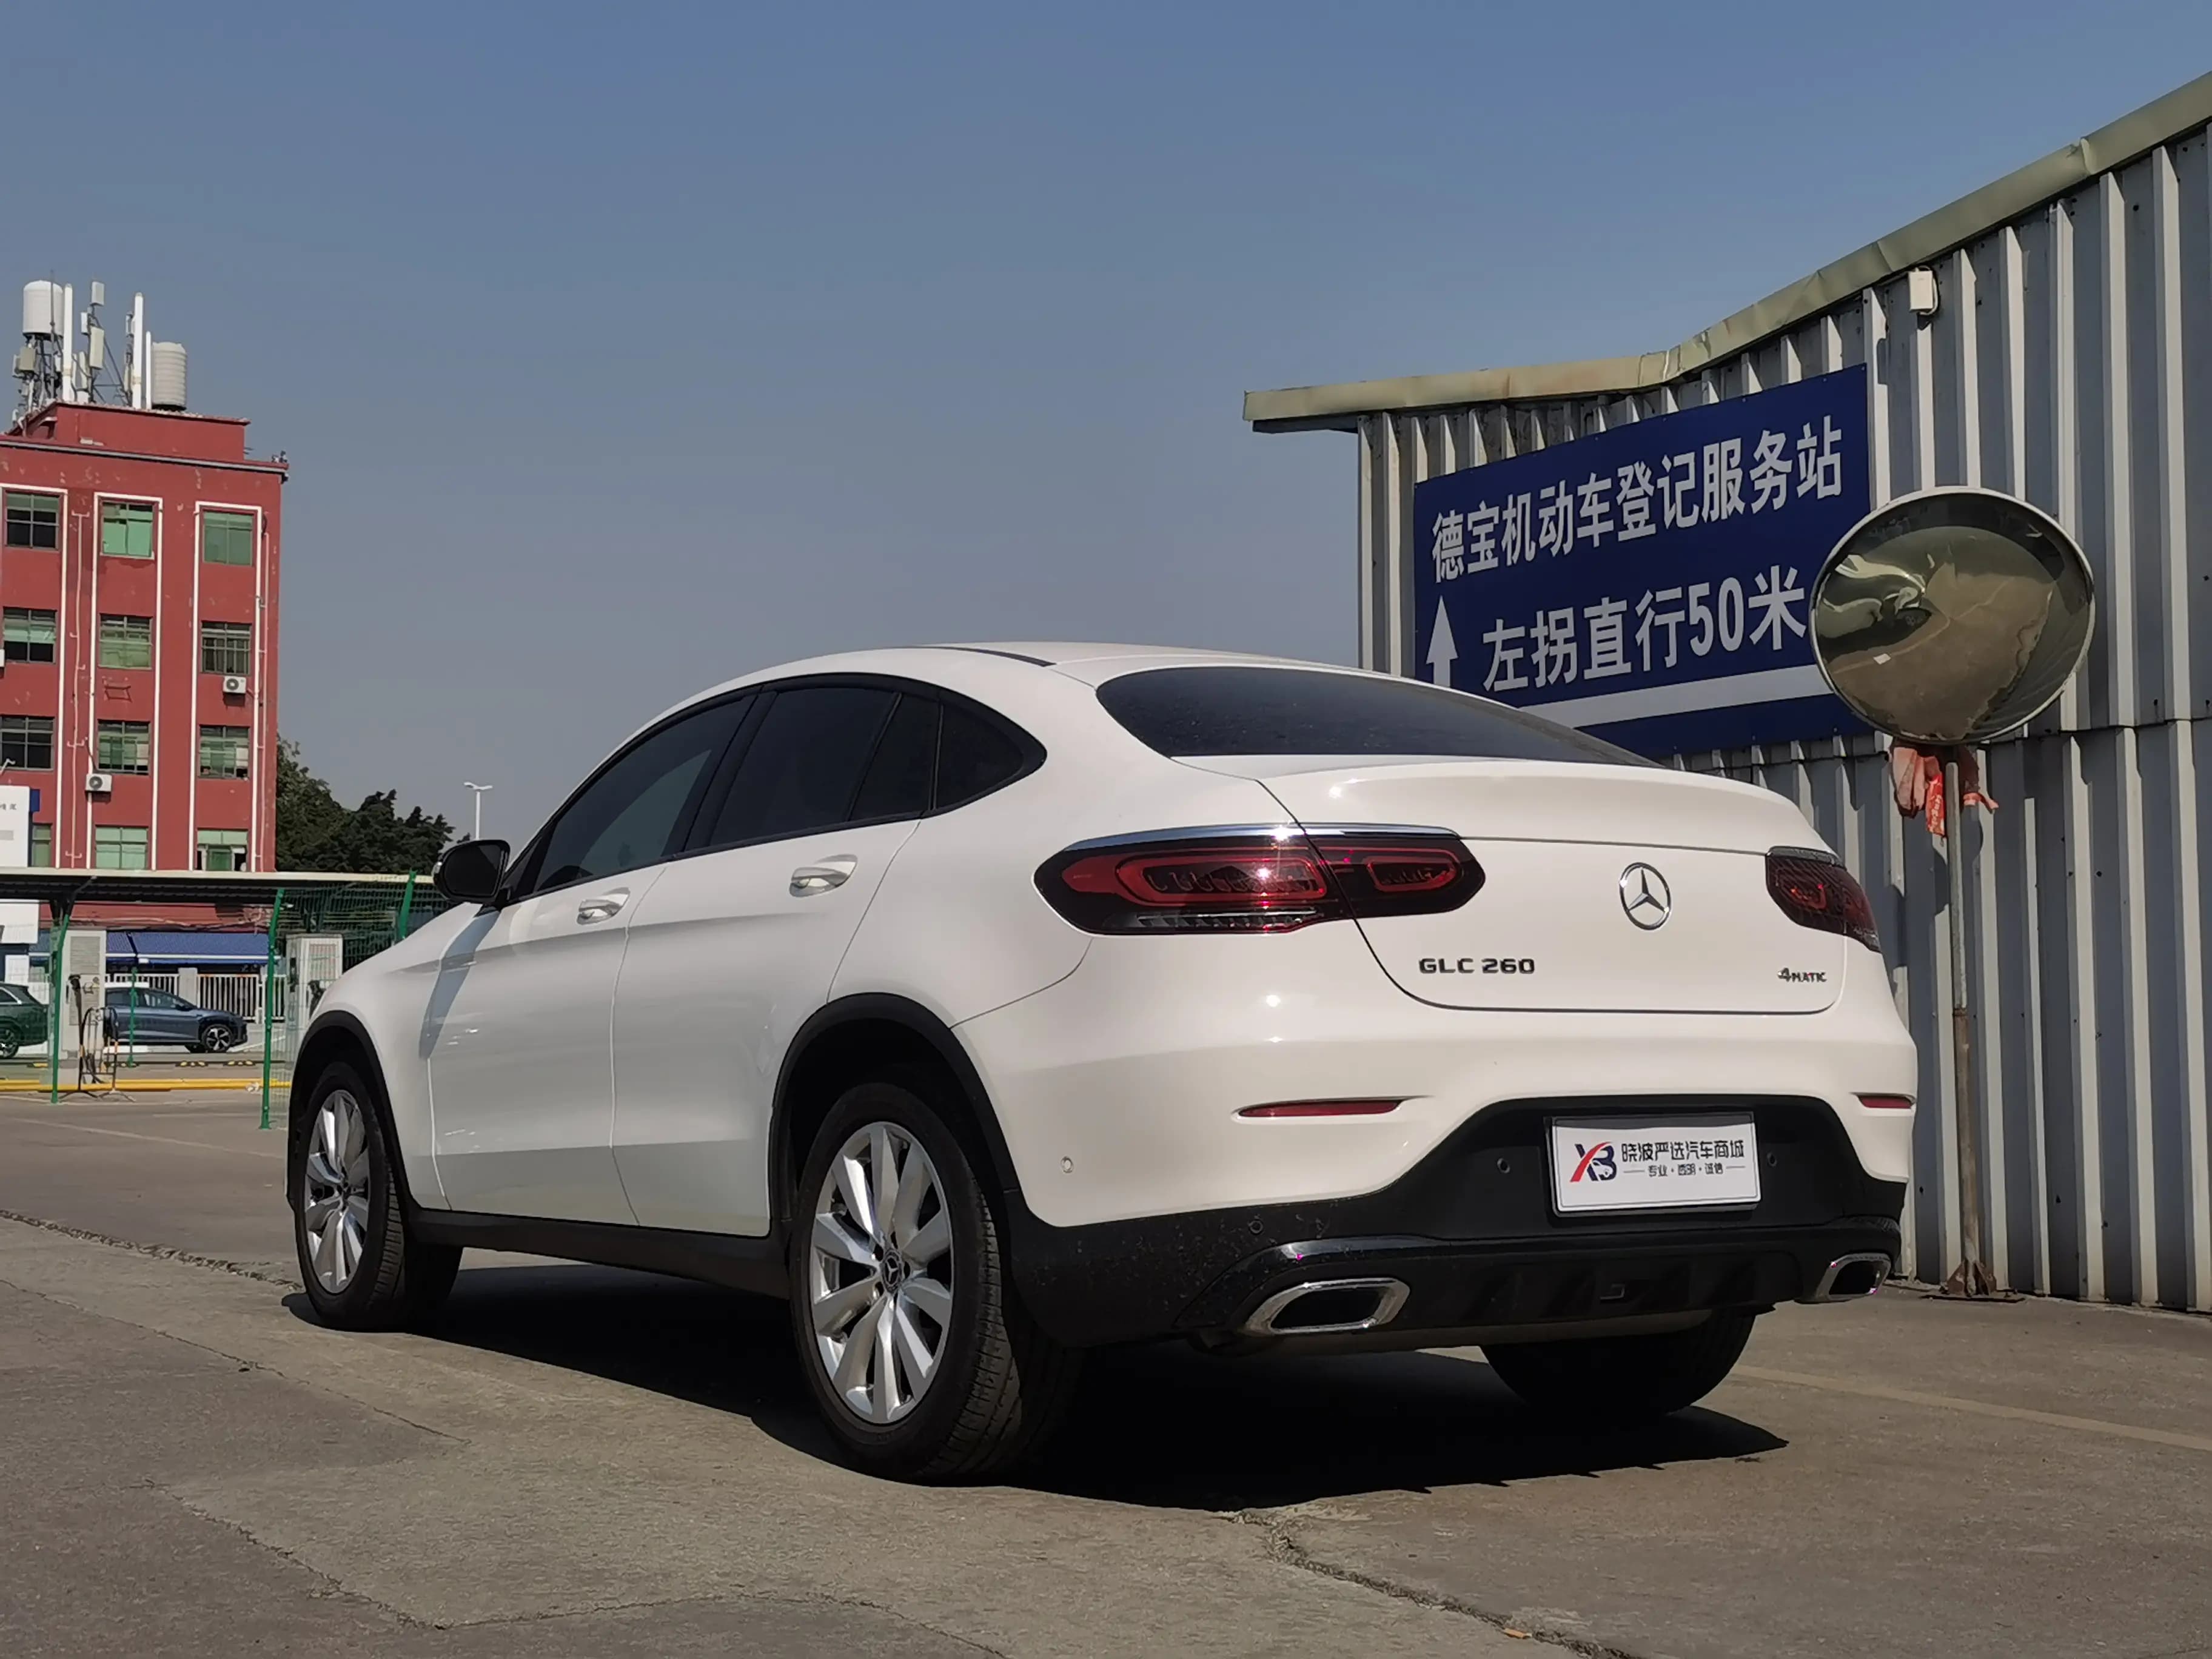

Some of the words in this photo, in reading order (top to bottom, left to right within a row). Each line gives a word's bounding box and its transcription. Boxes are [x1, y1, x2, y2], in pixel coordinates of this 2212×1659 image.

[1431, 415, 1842, 583] 德宝机动车登记服务站
[1482, 565, 1806, 692] 左拐直行50米
[1418, 958, 1475, 974] GLC
[1481, 958, 1535, 974] 260
[1777, 967, 1828, 983] 4MATIC
[1621, 1140, 1744, 1162] 晓波严选汽车商城
